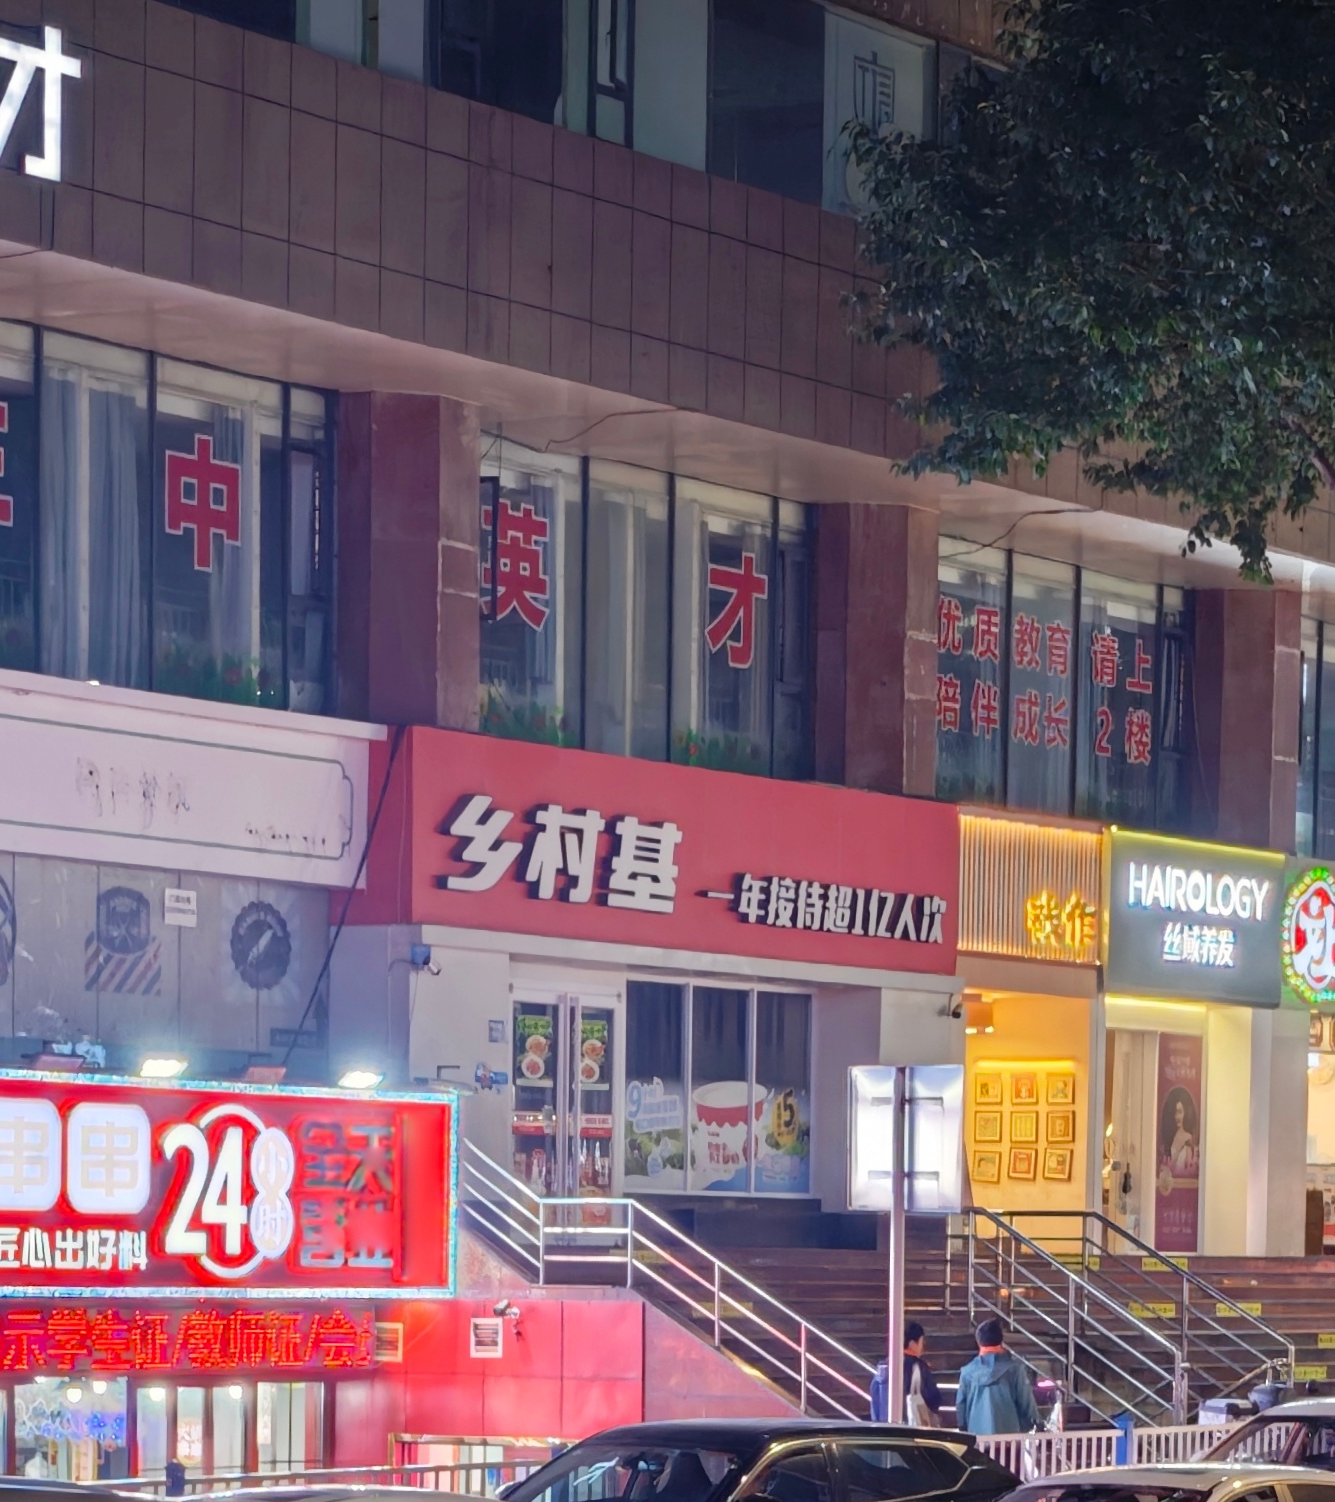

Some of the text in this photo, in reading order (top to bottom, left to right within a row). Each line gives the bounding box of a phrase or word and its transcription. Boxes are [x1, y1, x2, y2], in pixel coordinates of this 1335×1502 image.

[446, 795, 948, 945] 乡村基 一年接待超1亿人次
[1128, 861, 1270, 922] HAIROLOGY
[1162, 922, 1237, 968] 丝域养发
